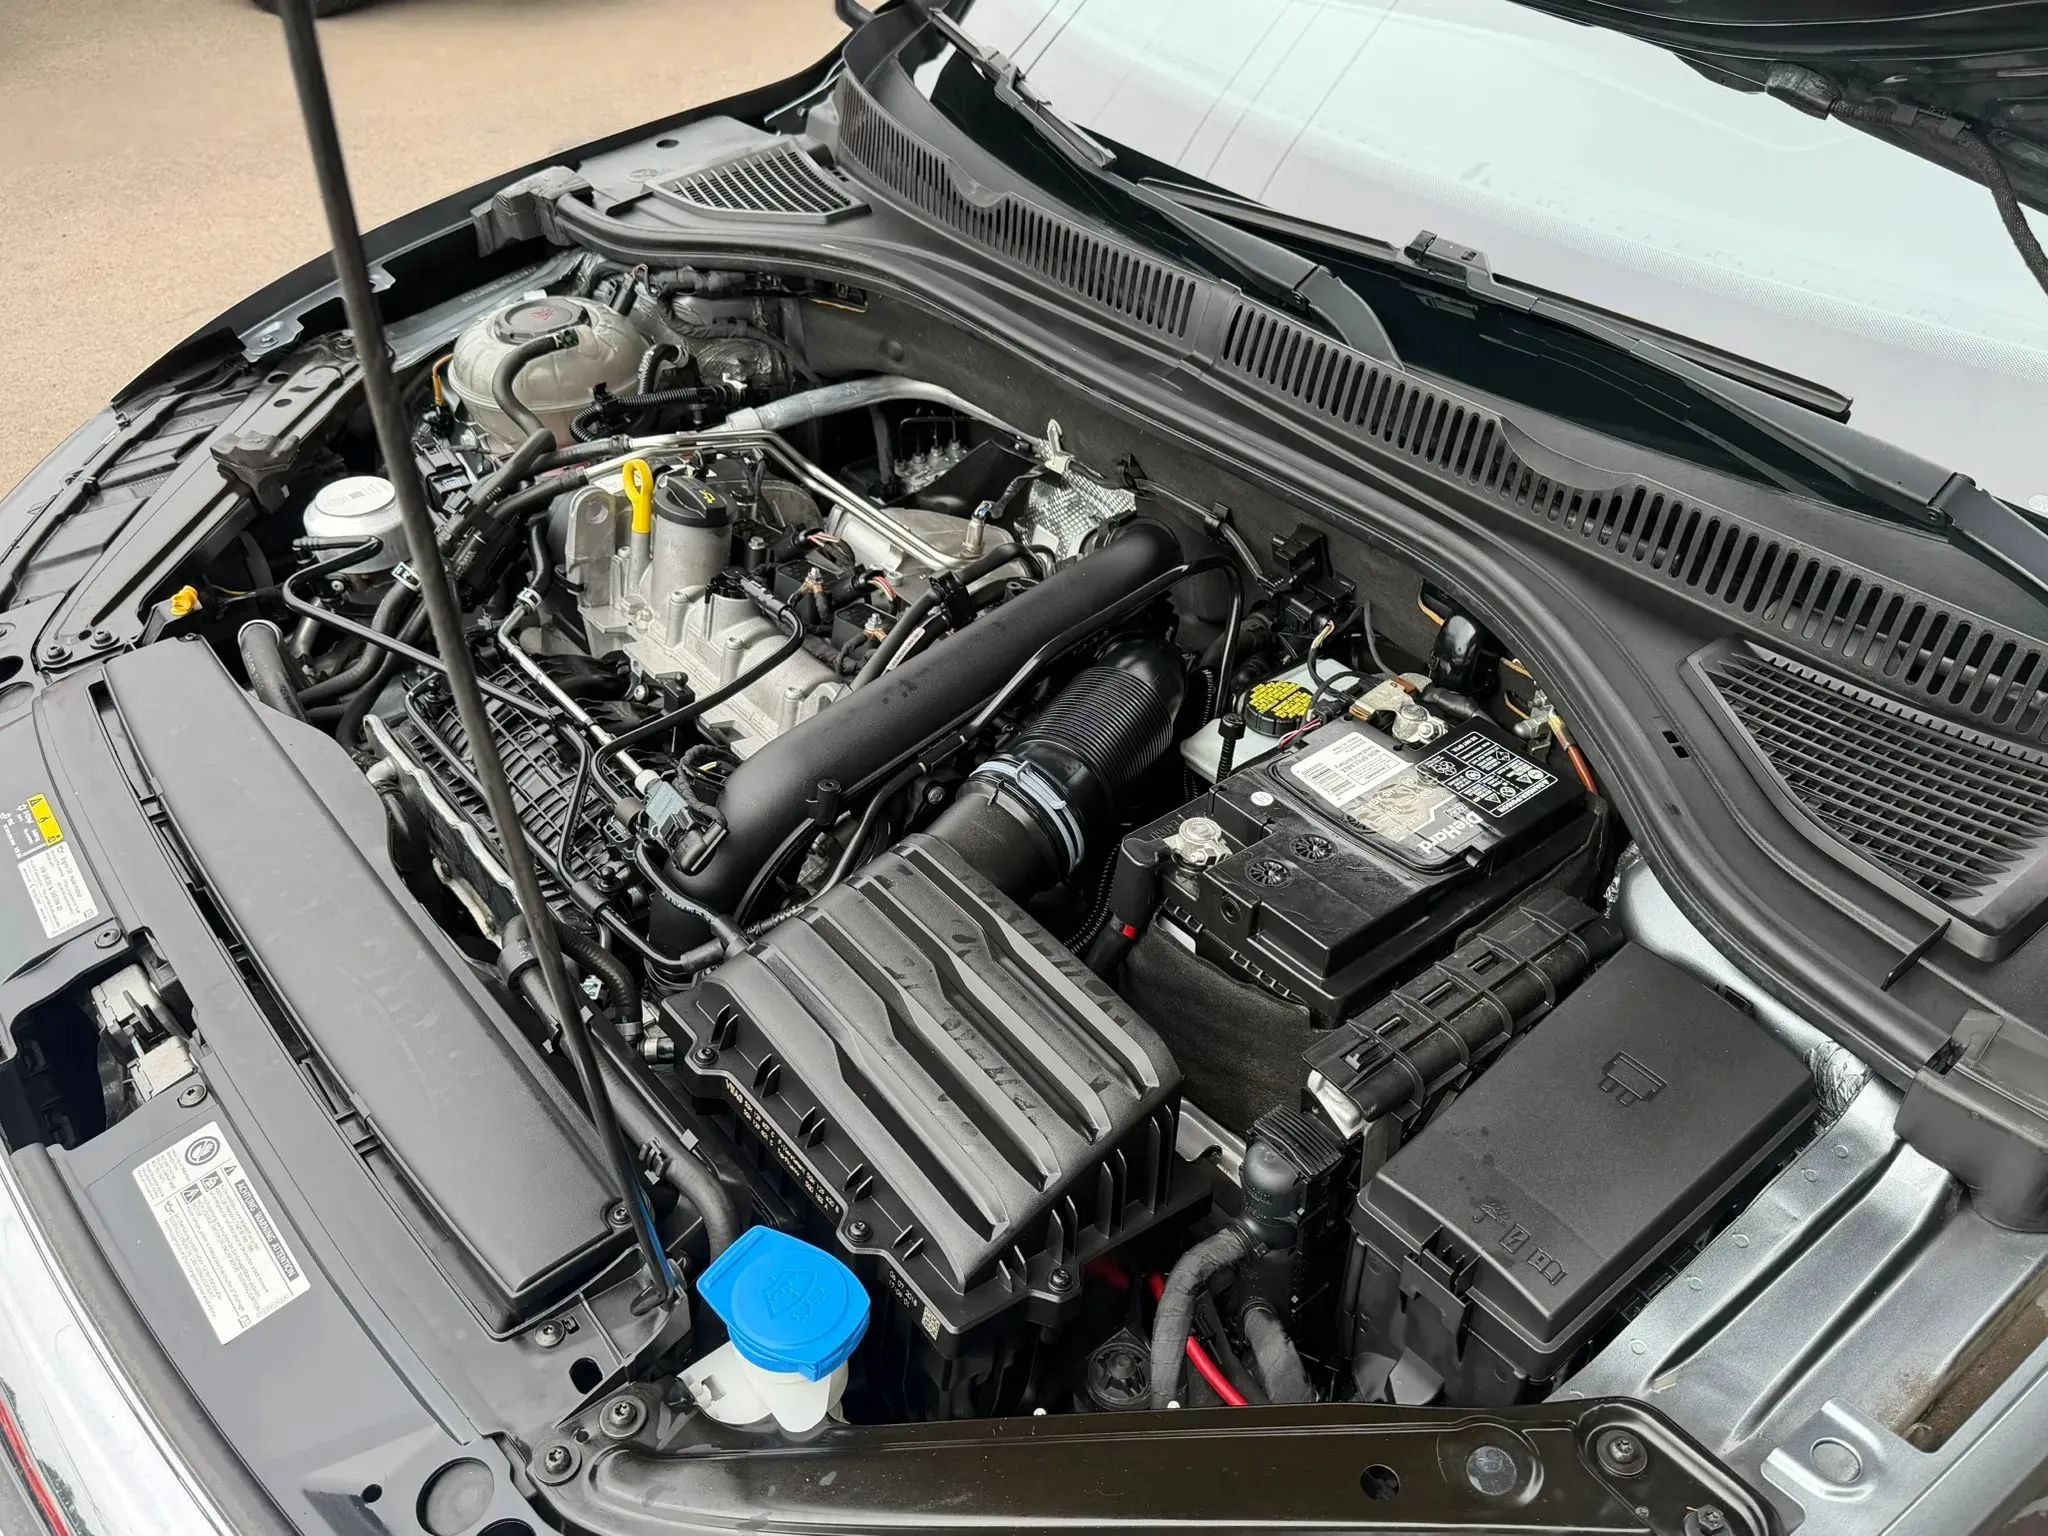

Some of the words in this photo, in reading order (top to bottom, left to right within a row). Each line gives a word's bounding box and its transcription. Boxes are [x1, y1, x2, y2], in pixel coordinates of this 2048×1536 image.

[1417, 811, 1483, 854] DieHard
[237, 1182, 258, 1212] ACHTUNG
[254, 1211, 276, 1242] WARNING
[271, 1243, 296, 1277] ATTENTION
